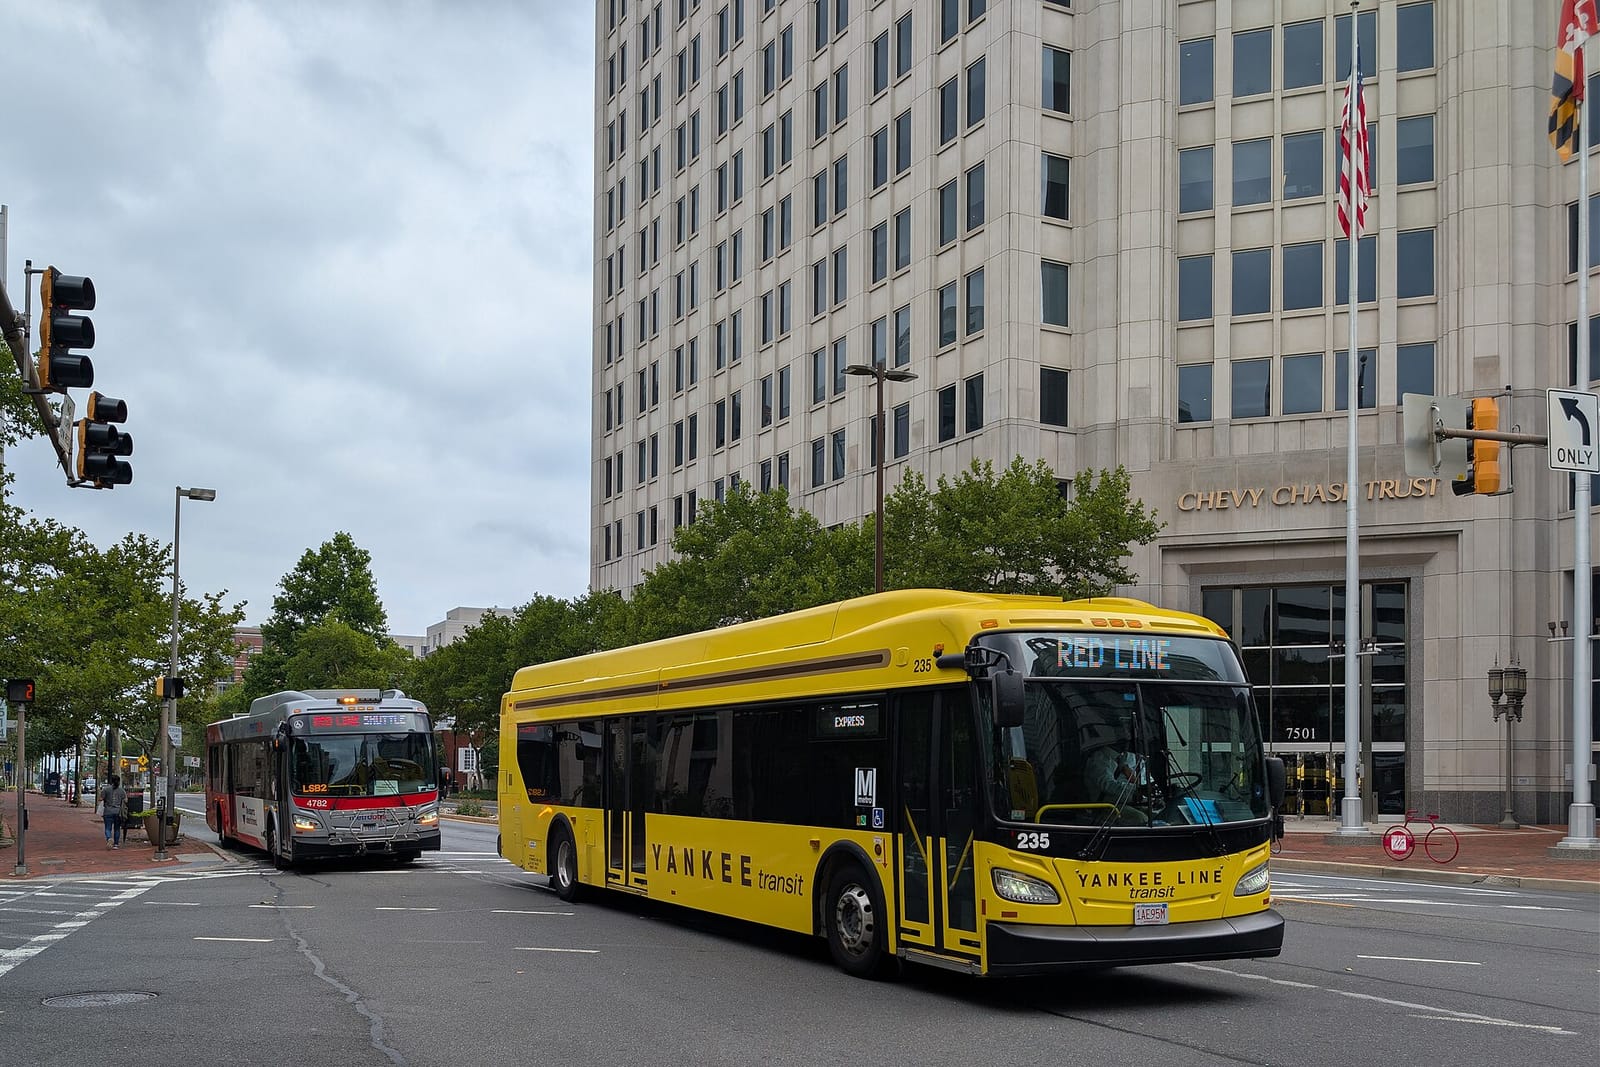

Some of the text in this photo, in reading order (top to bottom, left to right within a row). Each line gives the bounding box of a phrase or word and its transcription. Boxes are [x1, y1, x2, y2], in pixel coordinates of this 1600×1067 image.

[1557, 447, 1593, 465] ONLY
[1177, 487, 1264, 511] CHEVY
[1365, 478, 1440, 500] TRUST
[1057, 638, 1171, 670] RED LINE
[913, 658, 932, 673] 235
[363, 715, 406, 725] SHUTTLE
[834, 715, 865, 728] EXPRESS
[1286, 727, 1315, 739] 7501
[302, 783, 328, 793] LSB2
[858, 770, 873, 796] M
[306, 799, 328, 808] 4782
[1017, 832, 1050, 849] 235
[652, 843, 804, 897] YANKEE transit
[1079, 870, 1222, 887] YANKEE LINE
[1130, 886, 1175, 899] transit
[1136, 908, 1166, 920] 1AE95M
